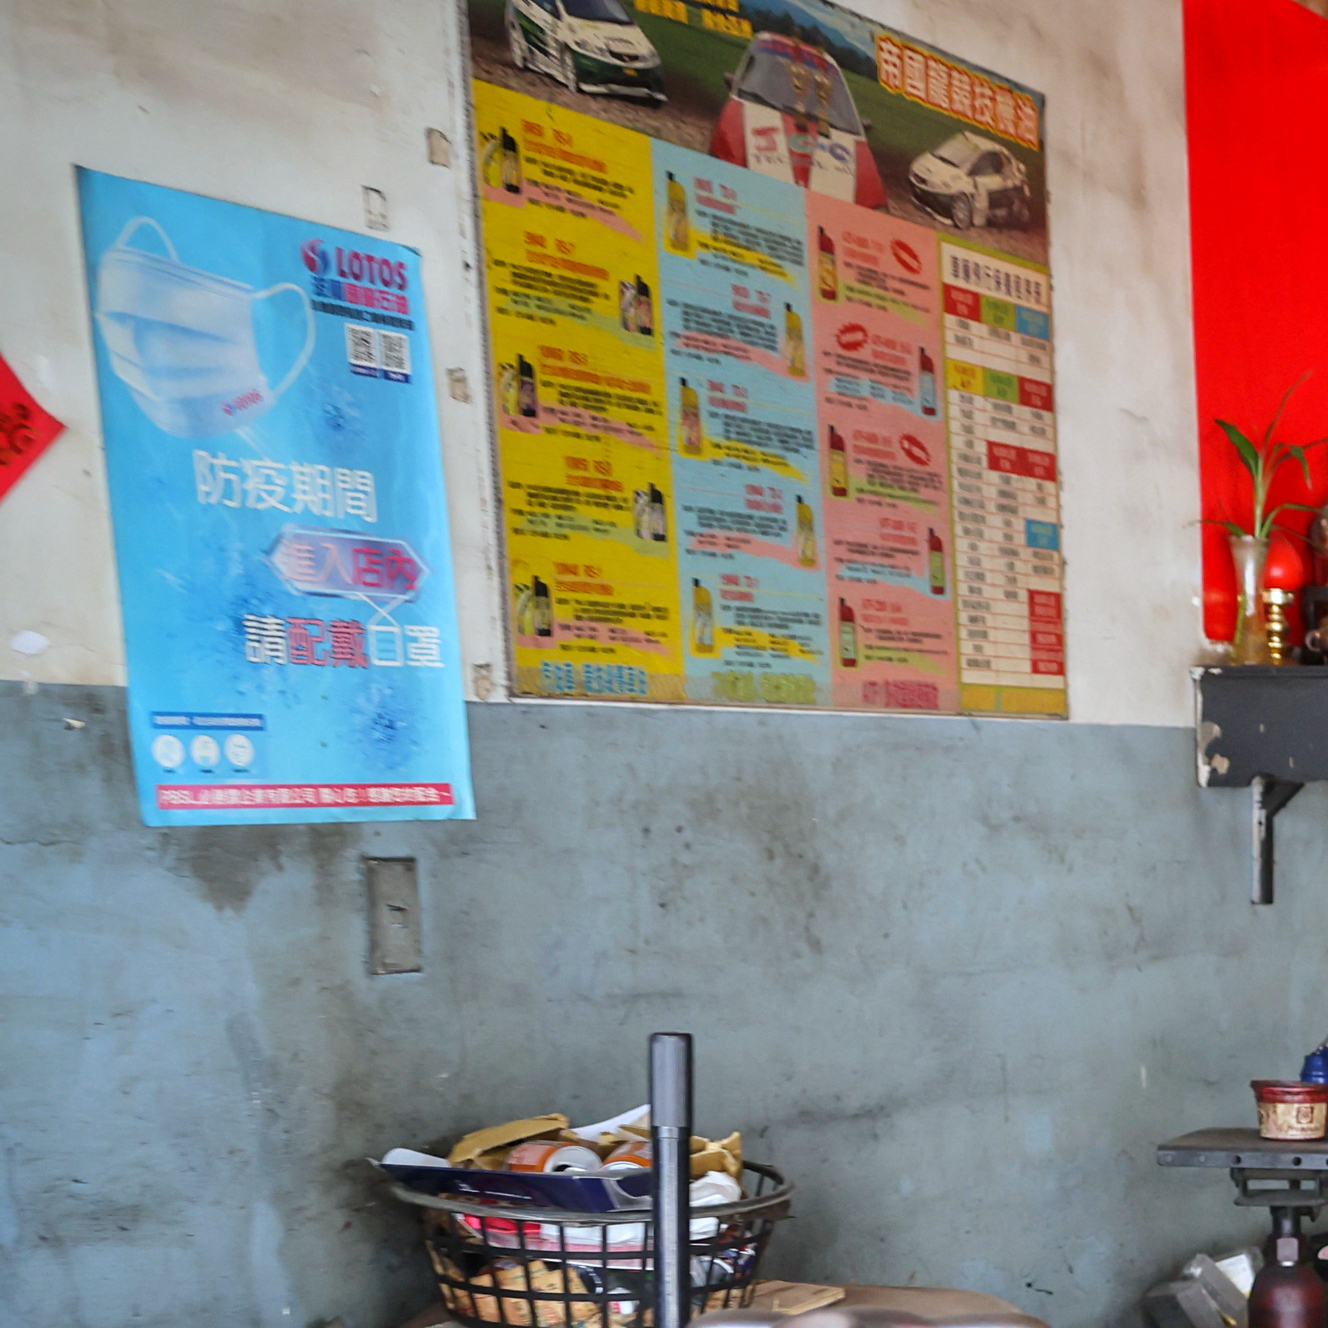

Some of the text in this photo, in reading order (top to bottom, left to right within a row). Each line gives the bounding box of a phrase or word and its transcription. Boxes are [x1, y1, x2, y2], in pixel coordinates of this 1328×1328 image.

[335, 246, 408, 290] LOTOS
[193, 449, 379, 523] 防疫期間
[280, 538, 418, 590] 進入店內
[243, 614, 446, 669] 請配戴口罩
